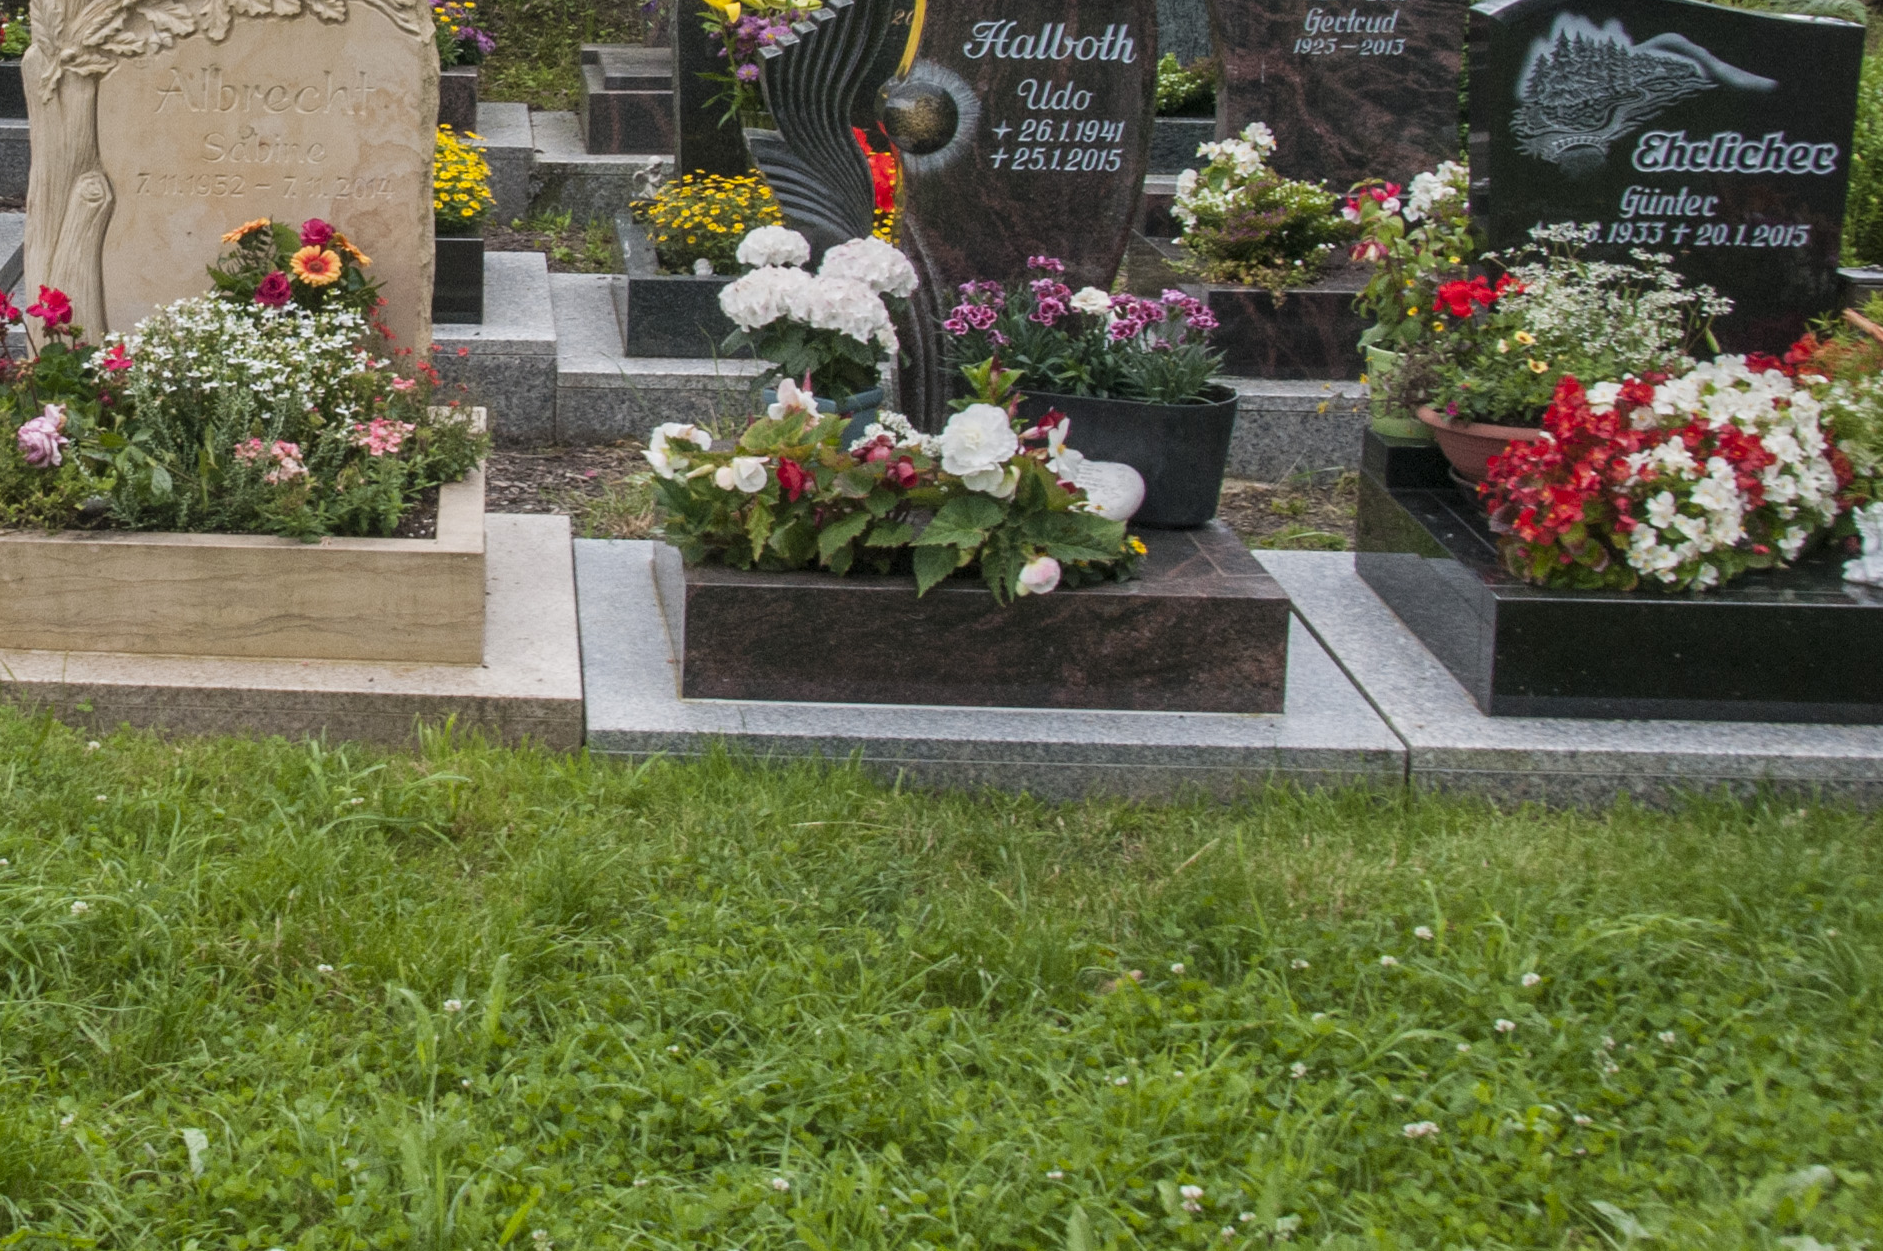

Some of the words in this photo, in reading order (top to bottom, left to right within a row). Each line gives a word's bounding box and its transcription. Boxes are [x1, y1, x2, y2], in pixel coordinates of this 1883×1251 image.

[1303, 7, 1400, 36] Gertrud
[963, 19, 1137, 64] Halboth
[1359, 38, 1406, 56] 2013
[154, 65, 375, 115] Albrecht
[1017, 78, 1094, 111] Udo
[200, 132, 327, 164] Sabine
[1631, 129, 1839, 174] Ehrlicher
[1619, 184, 1718, 218] Günter
